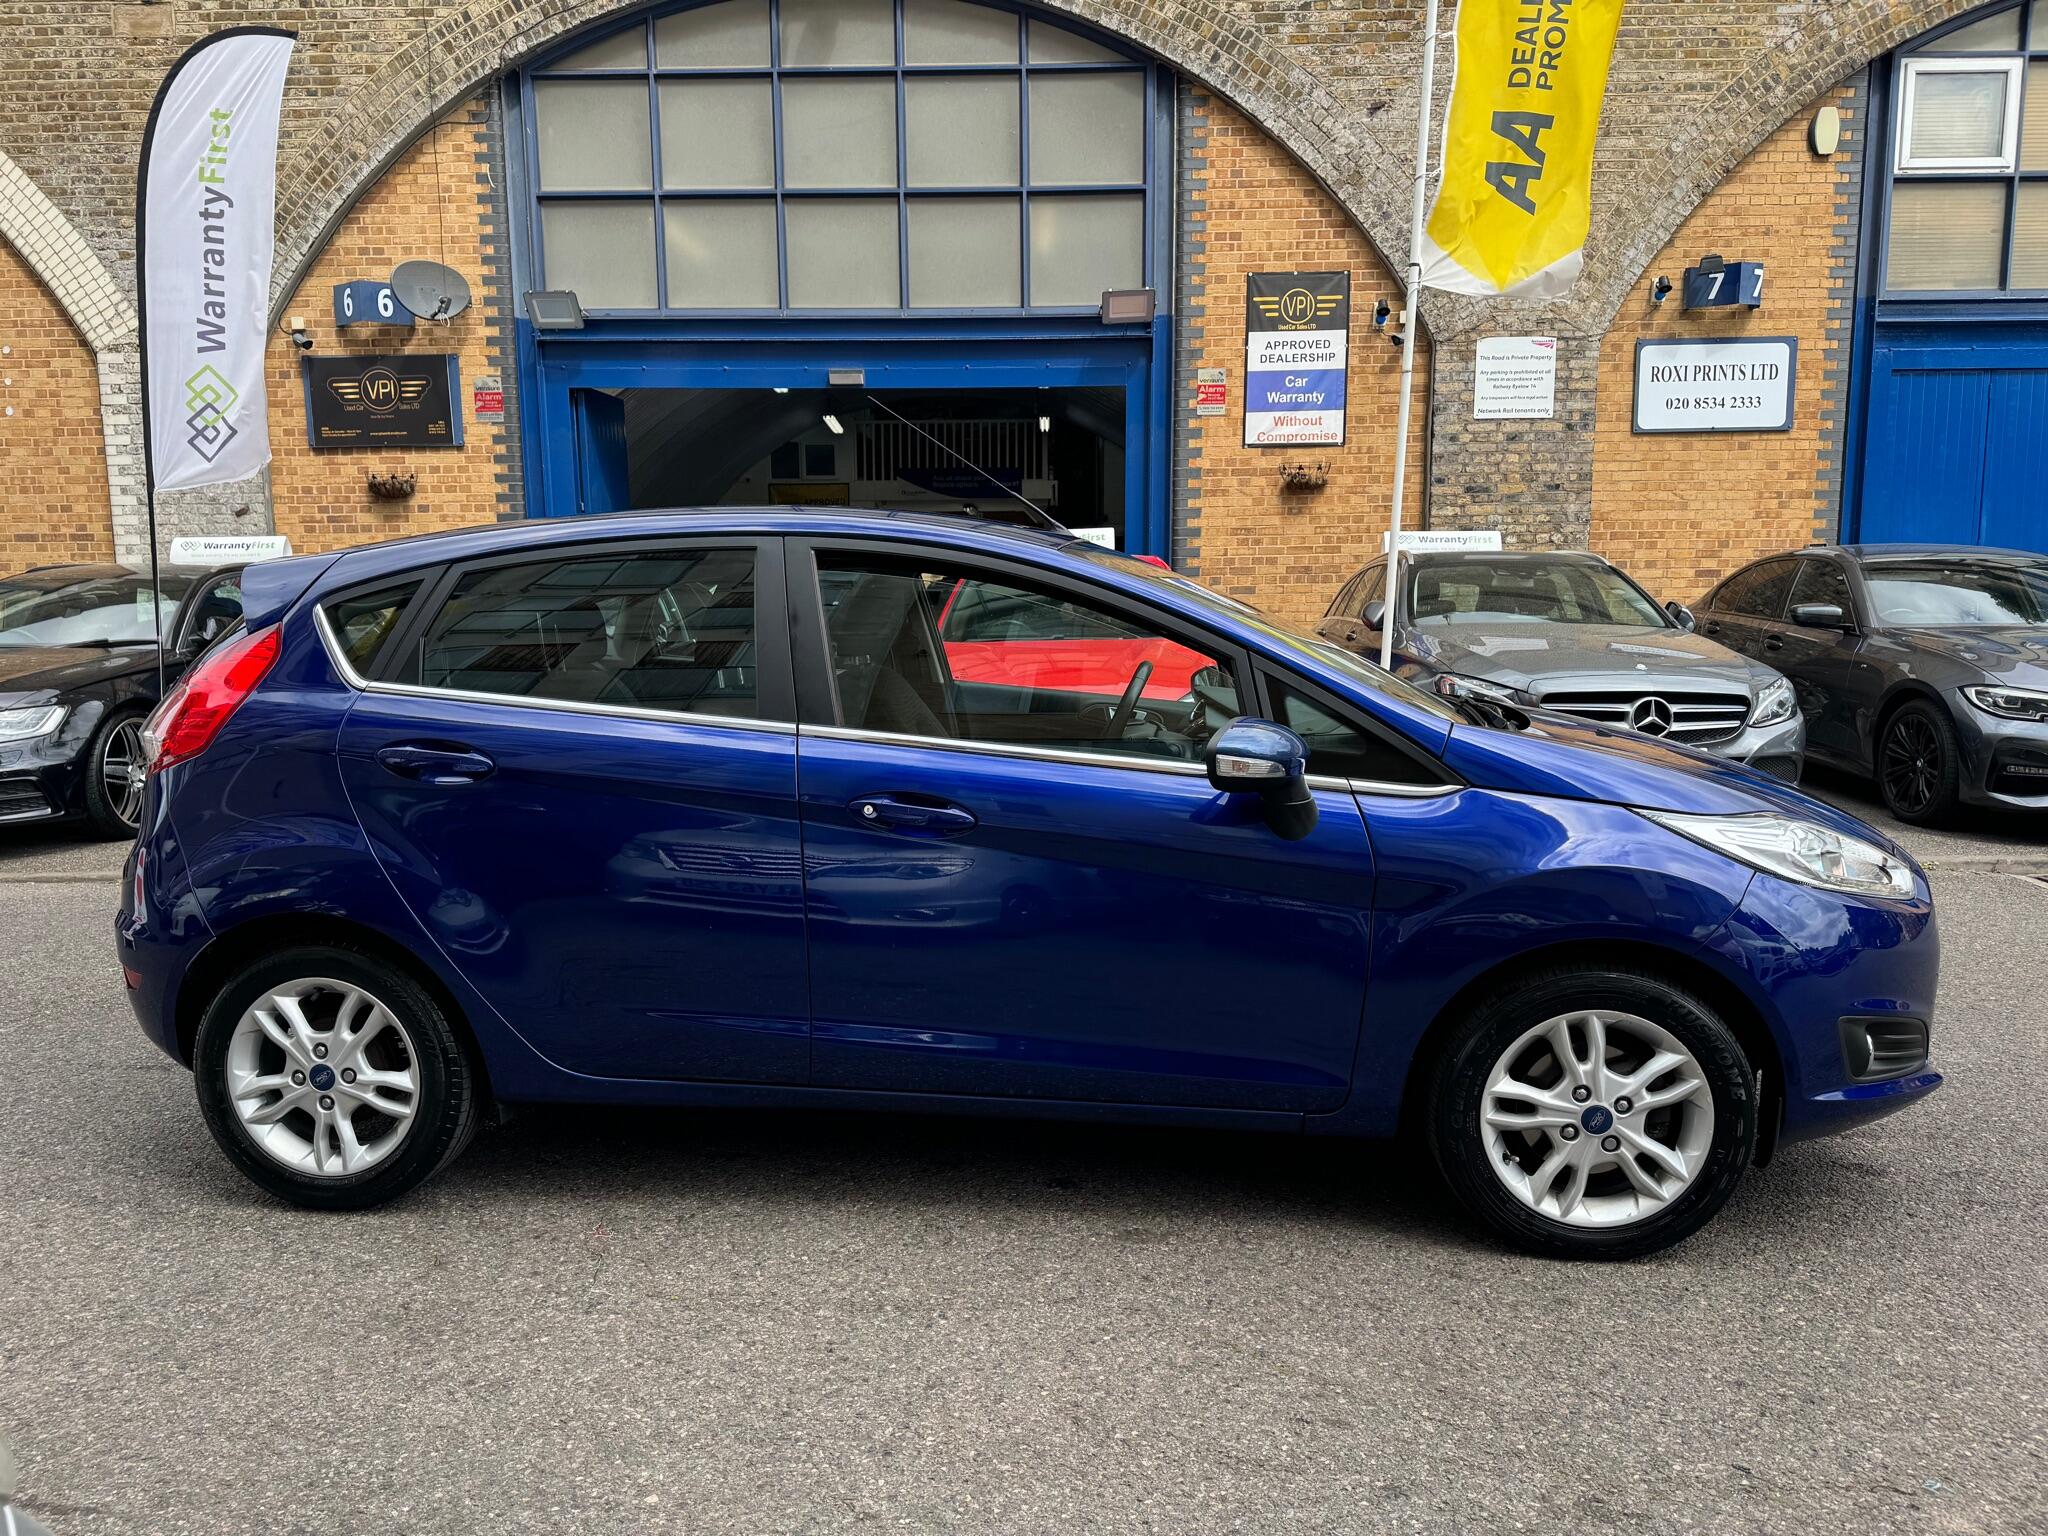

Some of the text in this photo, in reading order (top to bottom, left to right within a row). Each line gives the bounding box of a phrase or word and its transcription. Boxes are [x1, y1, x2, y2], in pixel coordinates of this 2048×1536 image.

[1507, 0, 1544, 88] DEAL
[1484, 110, 1555, 217] AA
[196, 107, 234, 354] WarrantyFirst
[1707, 272, 1725, 300] 7
[1752, 268, 1764, 297] 7
[343, 287, 354, 318] 6
[377, 288, 394, 318] 6
[1285, 296, 1311, 317] VPI
[1264, 339, 1331, 350] APPROVED
[1260, 352, 1336, 364] DEALERSHIP
[1285, 376, 1308, 388] Car
[1650, 363, 1779, 383] ROXI PRINTS LTD
[366, 380, 395, 400] VPI
[1266, 391, 1325, 404] Warranty
[1665, 396, 1762, 410] 020 8534 2333
[1273, 415, 1323, 427] Without
[1257, 430, 1338, 444] Compromise
[204, 541, 276, 551] WarrantyFirst
[1418, 535, 1493, 545] WarrantyFirst
